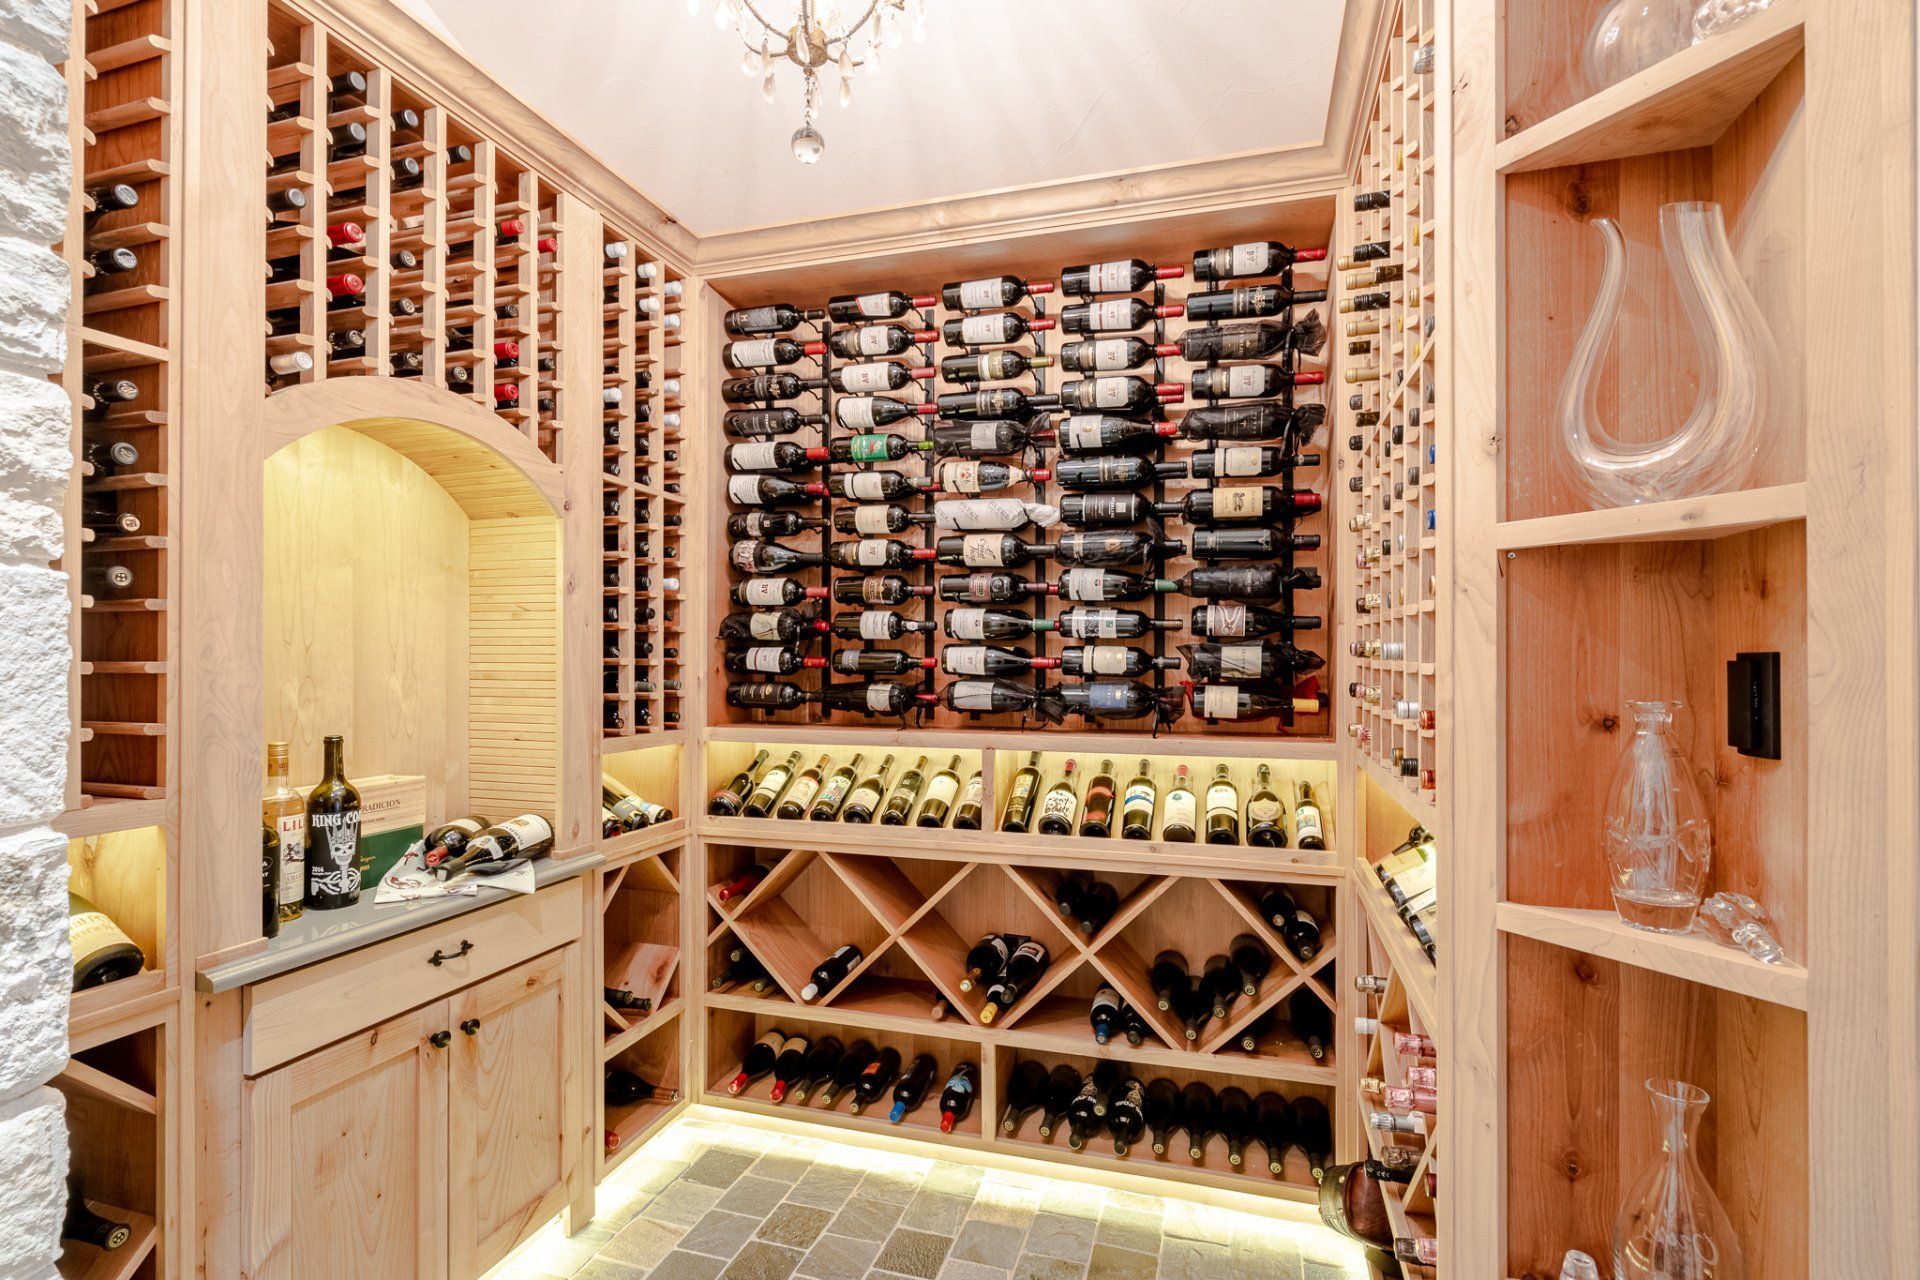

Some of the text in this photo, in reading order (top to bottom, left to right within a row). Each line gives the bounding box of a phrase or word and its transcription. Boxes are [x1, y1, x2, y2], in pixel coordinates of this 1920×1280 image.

[761, 584, 768, 595] BV
[362, 799, 400, 812] RADICION
[312, 814, 342, 827] KING
